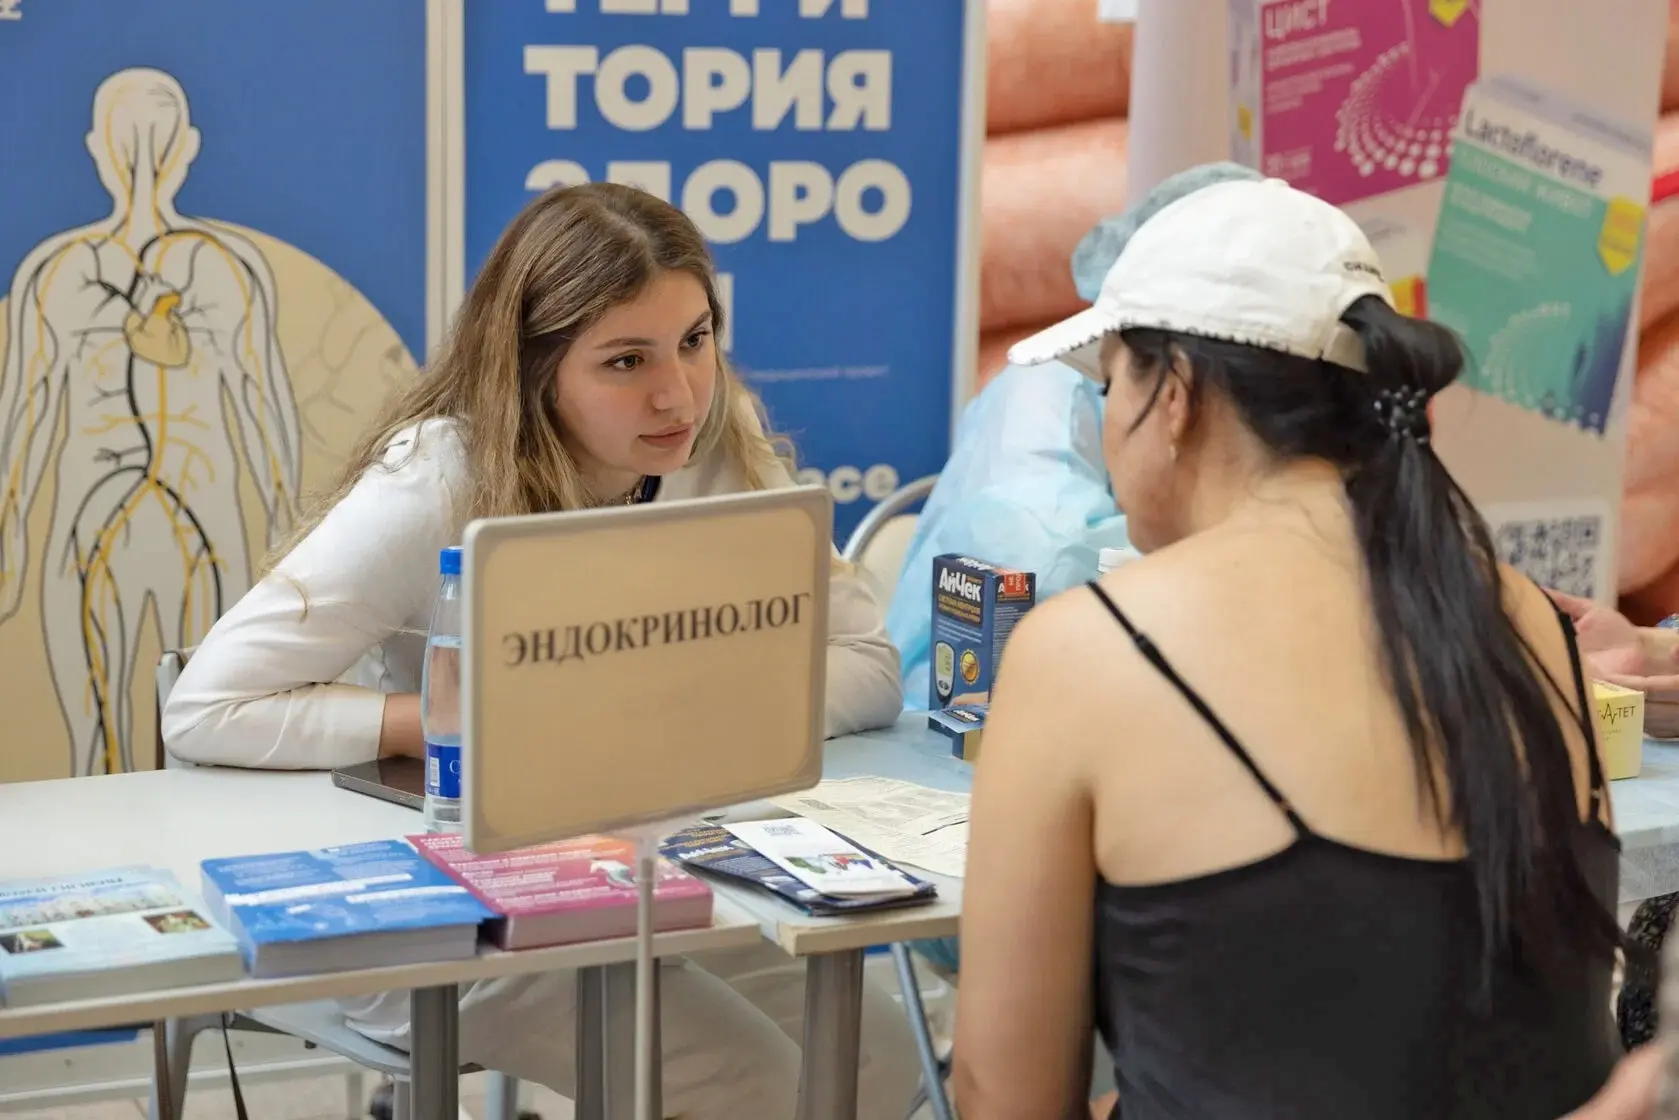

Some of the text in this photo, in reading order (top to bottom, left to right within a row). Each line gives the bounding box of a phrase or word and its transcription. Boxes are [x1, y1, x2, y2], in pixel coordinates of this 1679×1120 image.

[523, 44, 892, 131] ТОРИЯ
[939, 567, 982, 602] АйЧек
[503, 592, 811, 667] ЭНДОКРИНОЛОГ
